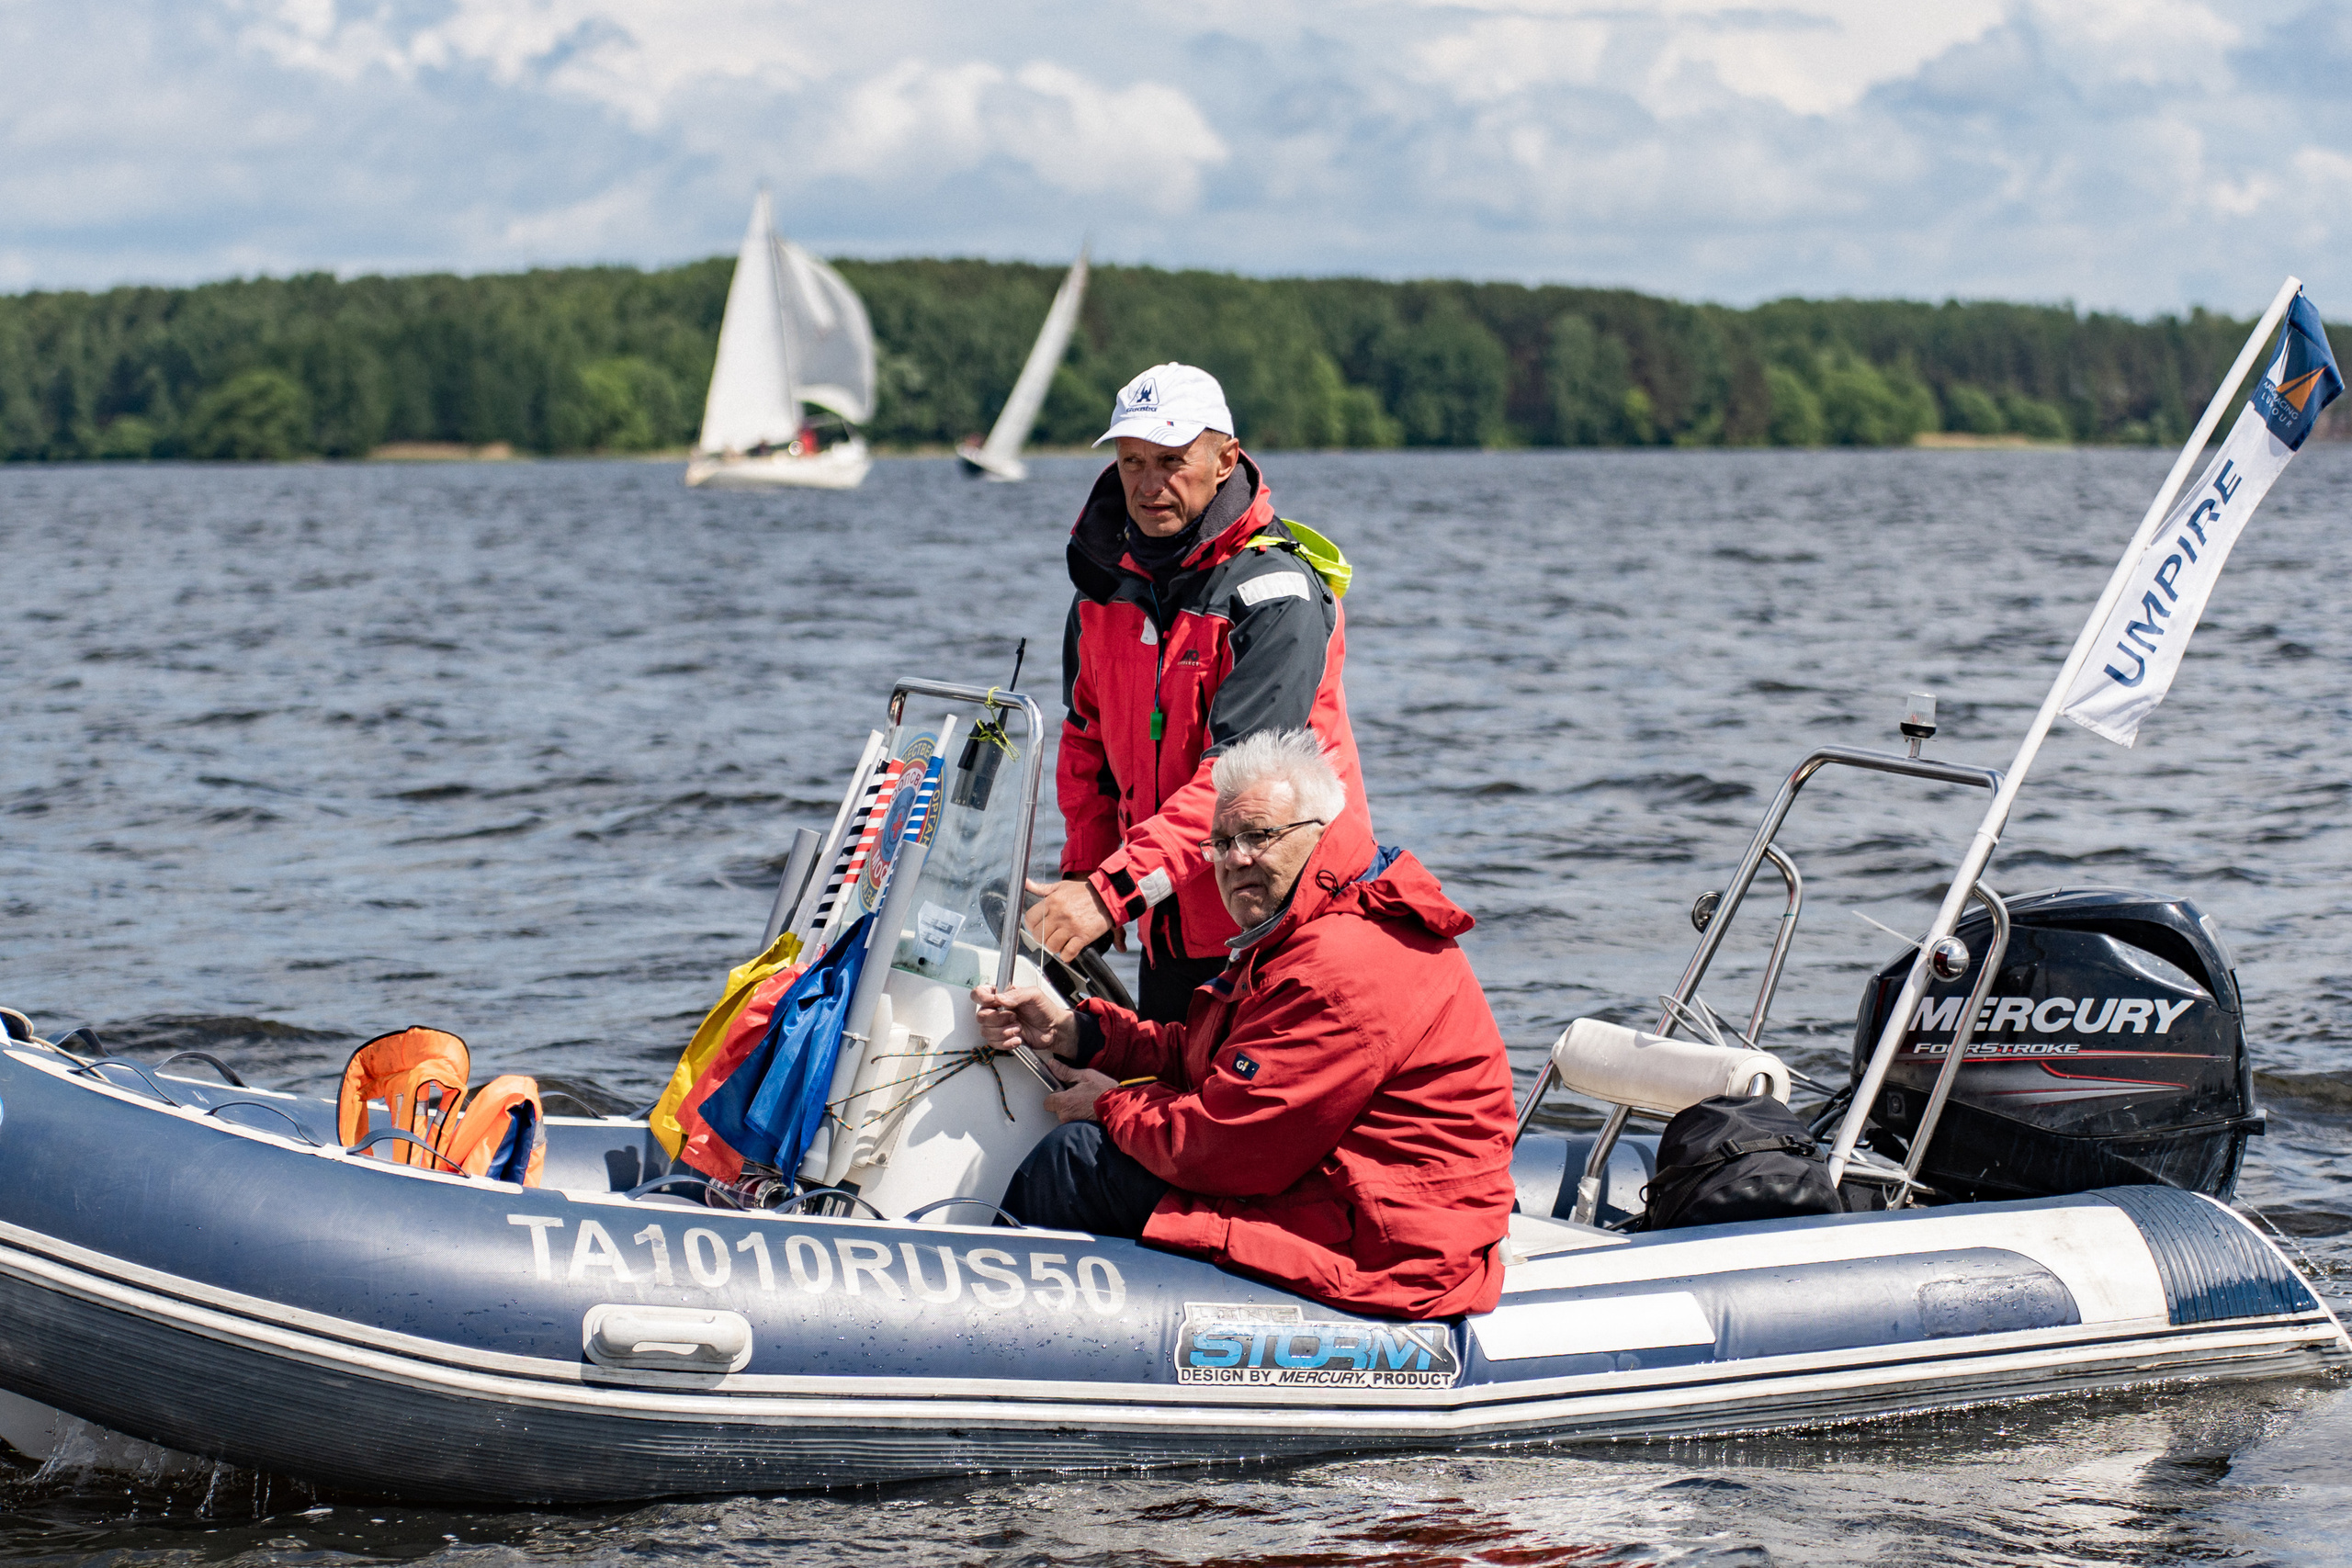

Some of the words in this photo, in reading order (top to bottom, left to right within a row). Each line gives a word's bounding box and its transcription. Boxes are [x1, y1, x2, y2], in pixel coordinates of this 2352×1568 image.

[2103, 458, 2243, 688] UMPIRE
[1908, 996, 2195, 1034] MERCURY
[1913, 1043, 2082, 1055] FORSTROKE
[1189, 1324, 1437, 1371] STORM
[1182, 1369, 1244, 1382] DESIGN
[1250, 1370, 1272, 1382] BY
[1373, 1372, 1451, 1386] PRODUCT
